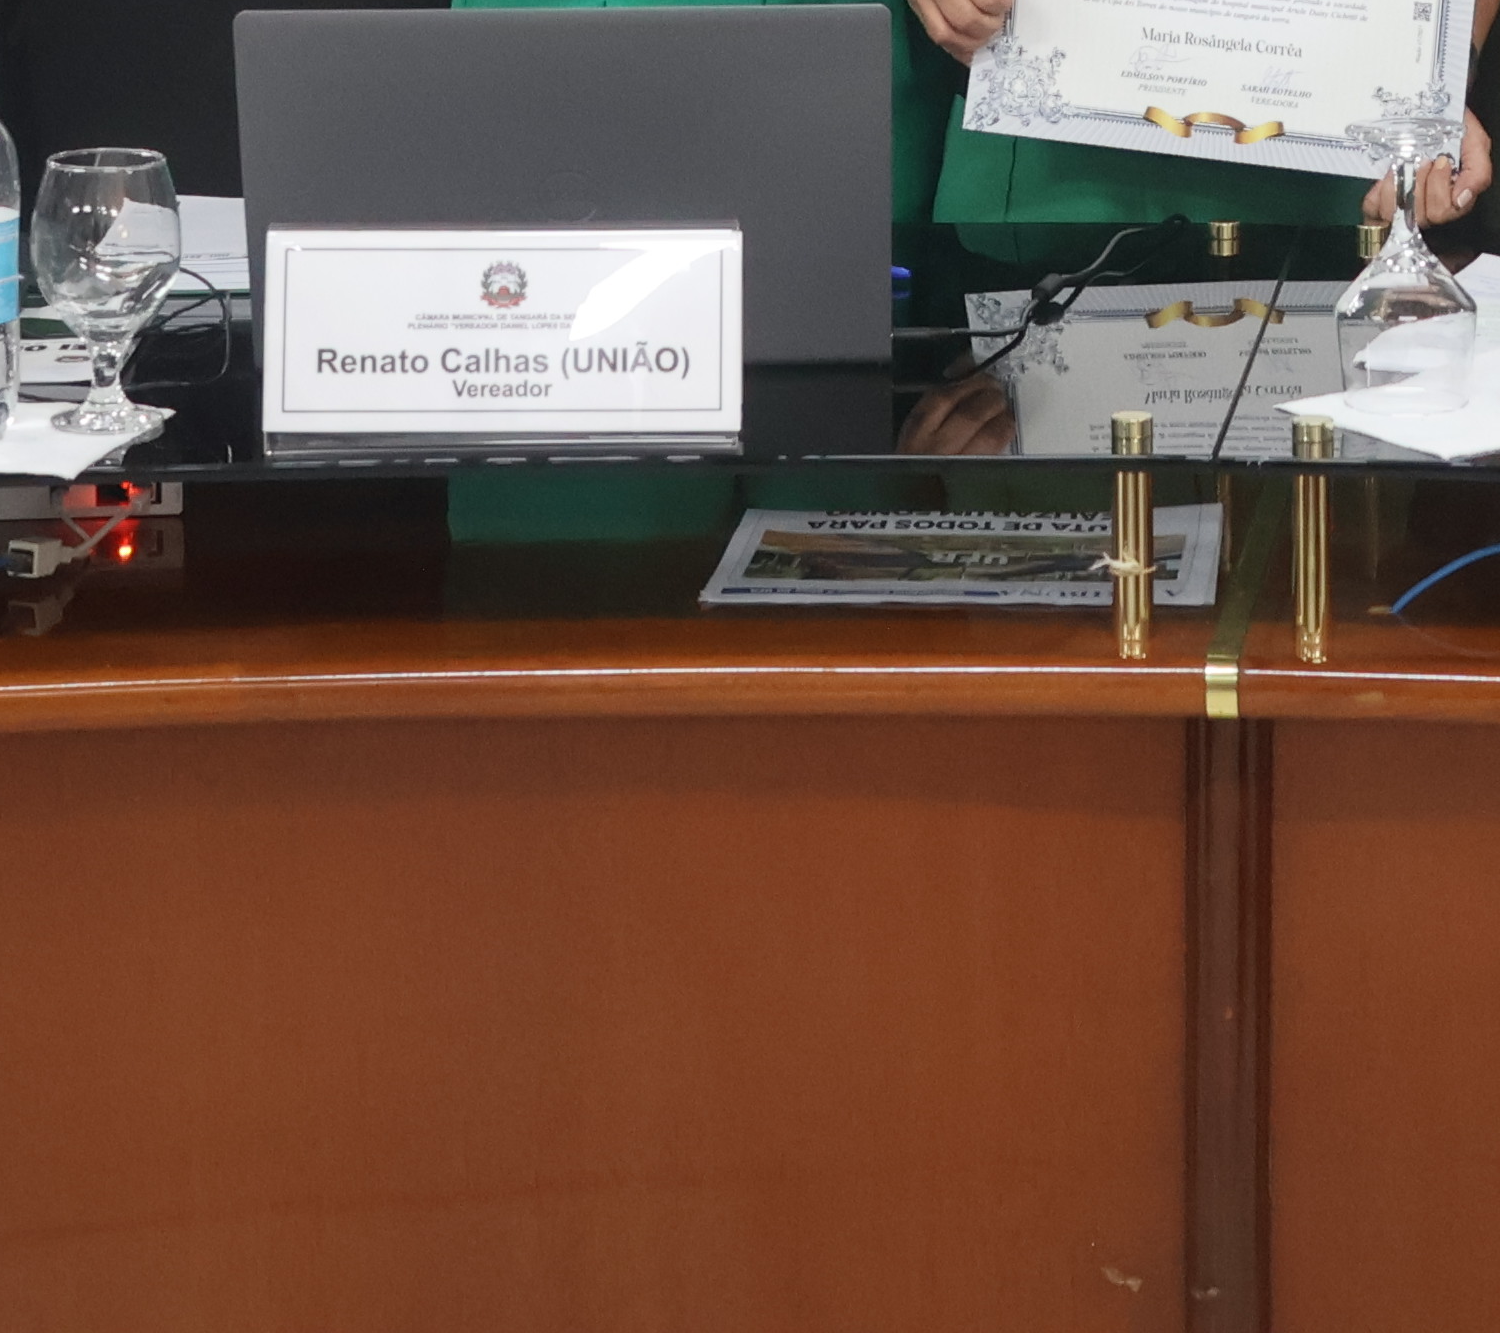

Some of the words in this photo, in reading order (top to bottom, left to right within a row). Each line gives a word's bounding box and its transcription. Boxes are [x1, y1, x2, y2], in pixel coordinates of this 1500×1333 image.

[1142, 27, 1180, 44] Maria
[1185, 32, 1252, 52] Rosângela
[1256, 40, 1302, 58] Corrêa
[316, 347, 429, 375] Renato
[440, 345, 549, 375] Calhas
[561, 342, 690, 380] (UNIÃO)
[452, 379, 553, 399] Vereador
[1051, 522, 1108, 532] UTA
